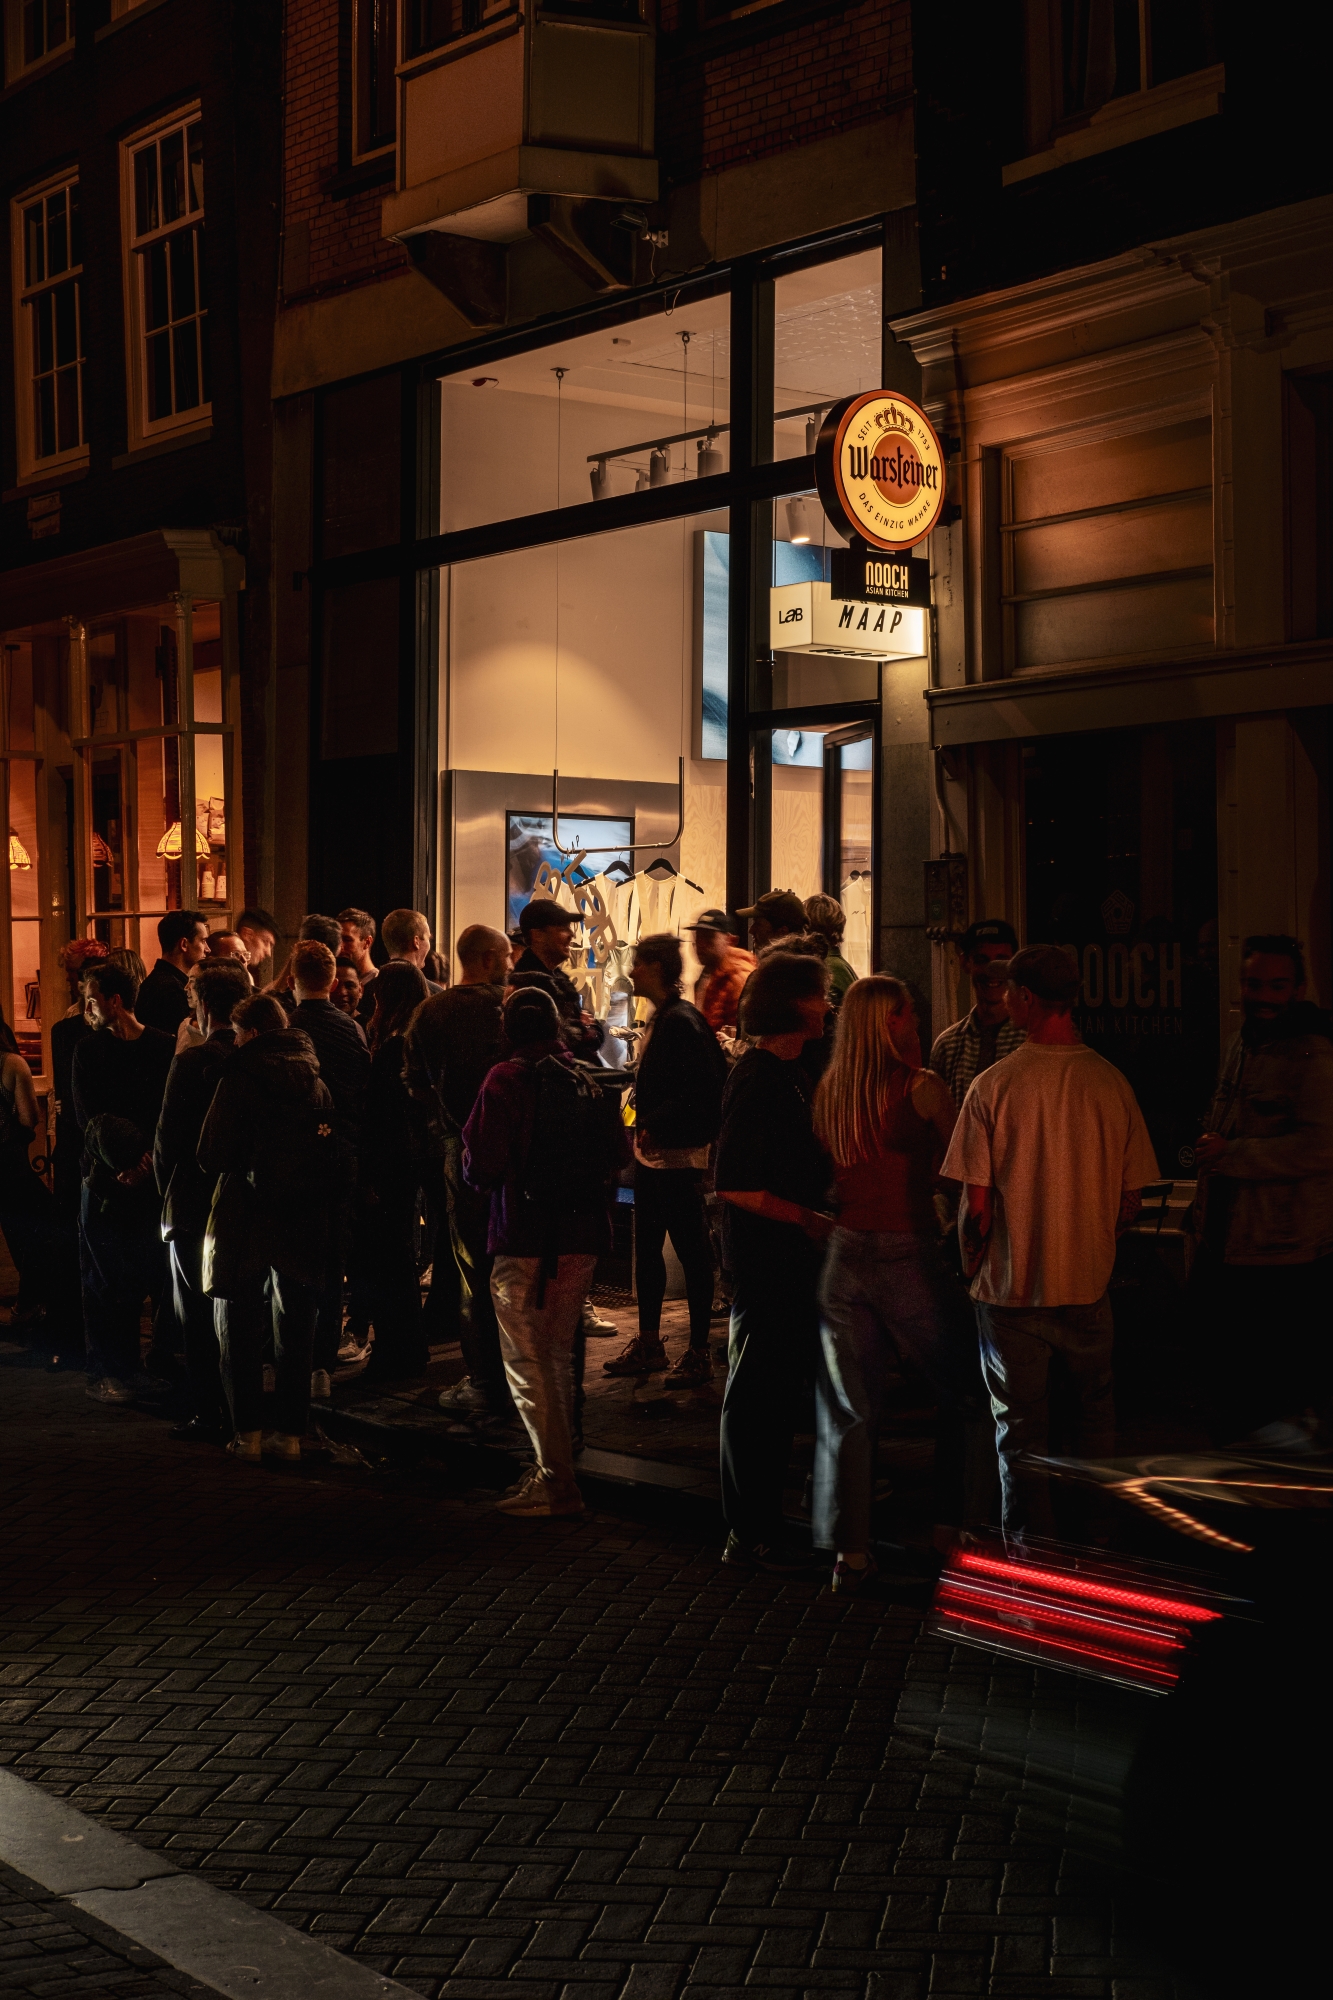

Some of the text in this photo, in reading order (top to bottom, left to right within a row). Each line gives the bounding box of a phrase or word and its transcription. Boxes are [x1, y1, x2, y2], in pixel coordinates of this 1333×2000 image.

[858, 420, 873, 441] SEIT
[848, 443, 938, 491] Warsteiner
[859, 492, 931, 529] DAS EINZIG WAHRE
[865, 561, 909, 590] NOOCH
[865, 586, 909, 599] ASIAN KITCHEN
[838, 605, 903, 633] MAAP
[1114, 1015, 1182, 1035] KITCHEN
